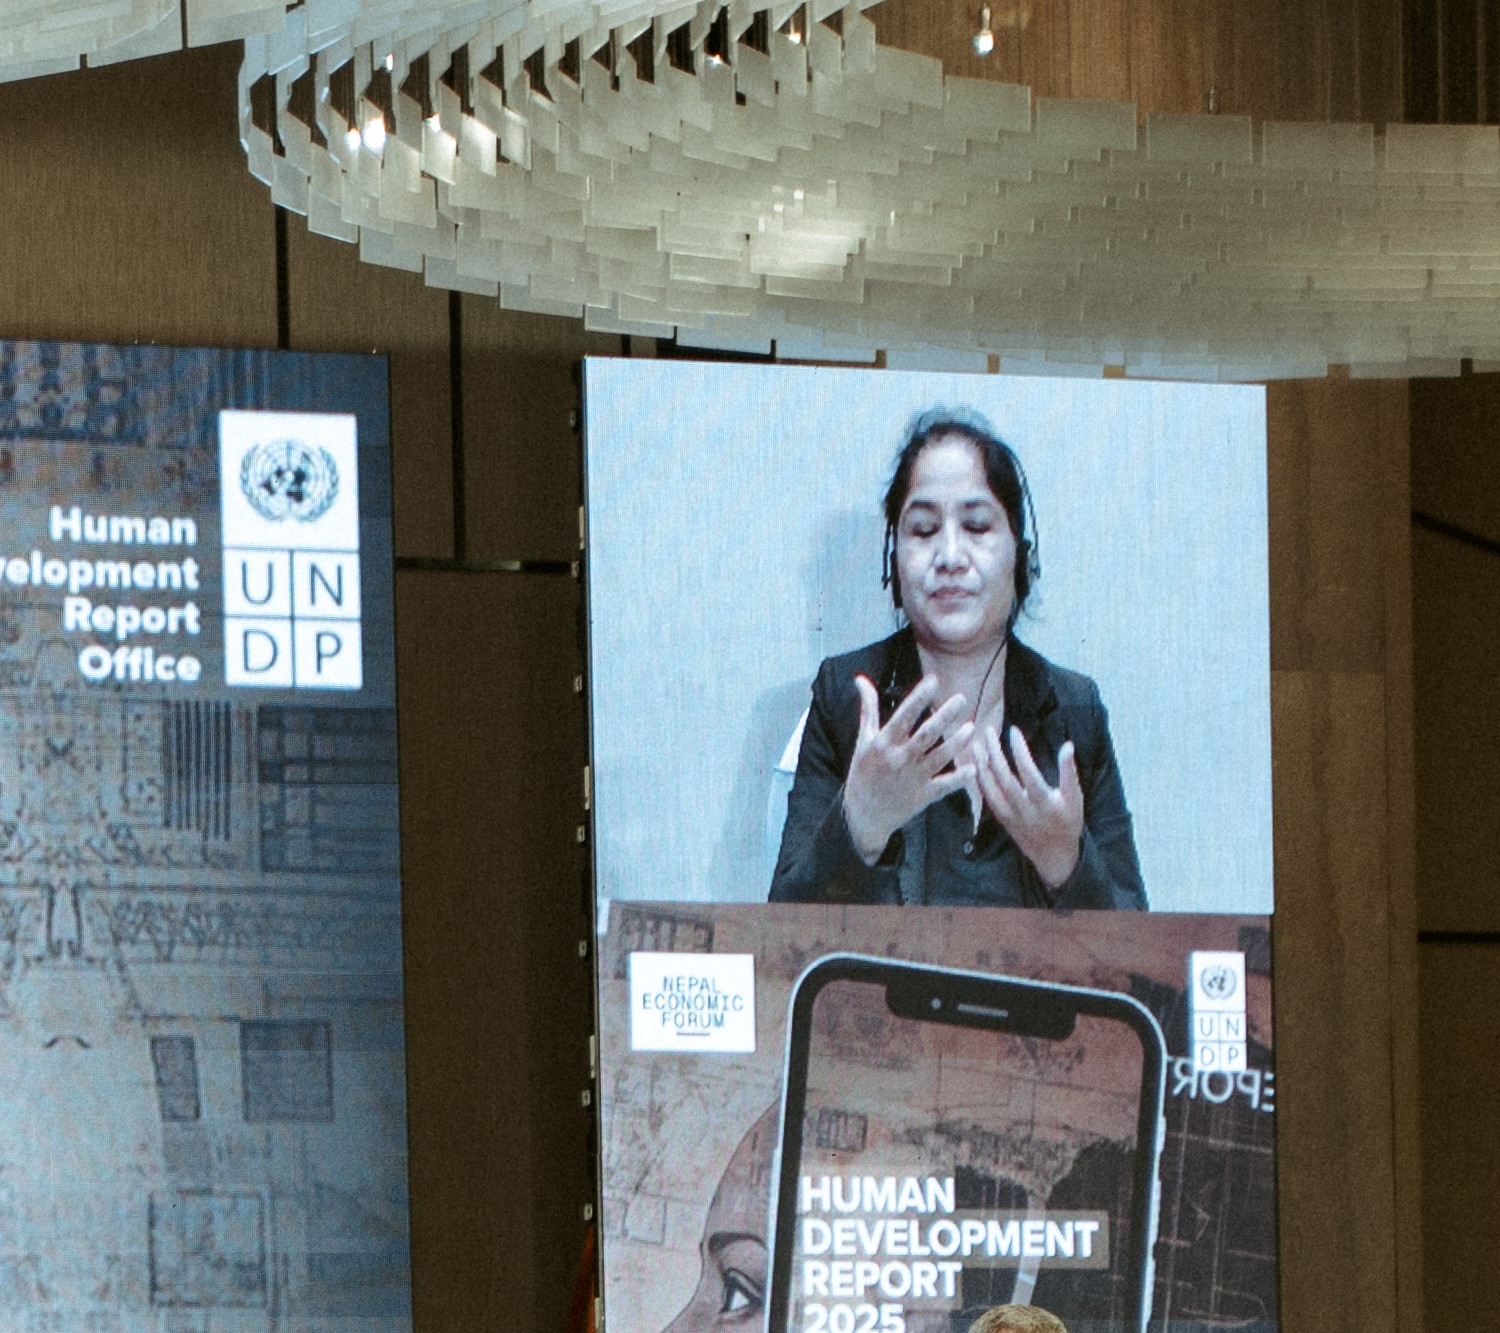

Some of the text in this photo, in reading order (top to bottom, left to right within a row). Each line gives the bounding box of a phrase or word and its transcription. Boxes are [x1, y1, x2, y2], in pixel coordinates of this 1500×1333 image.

[50, 506, 197, 544] Human
[63, 598, 200, 638] Report
[78, 646, 202, 682] Office
[642, 993, 744, 1011] ECONOMIC
[663, 976, 721, 993] NEPAL
[662, 1012, 724, 1029] FORUM
[802, 1177, 956, 1213] HUMAN
[802, 1219, 1099, 1258] DEVELOPMENT
[803, 1262, 963, 1298] REPORT
